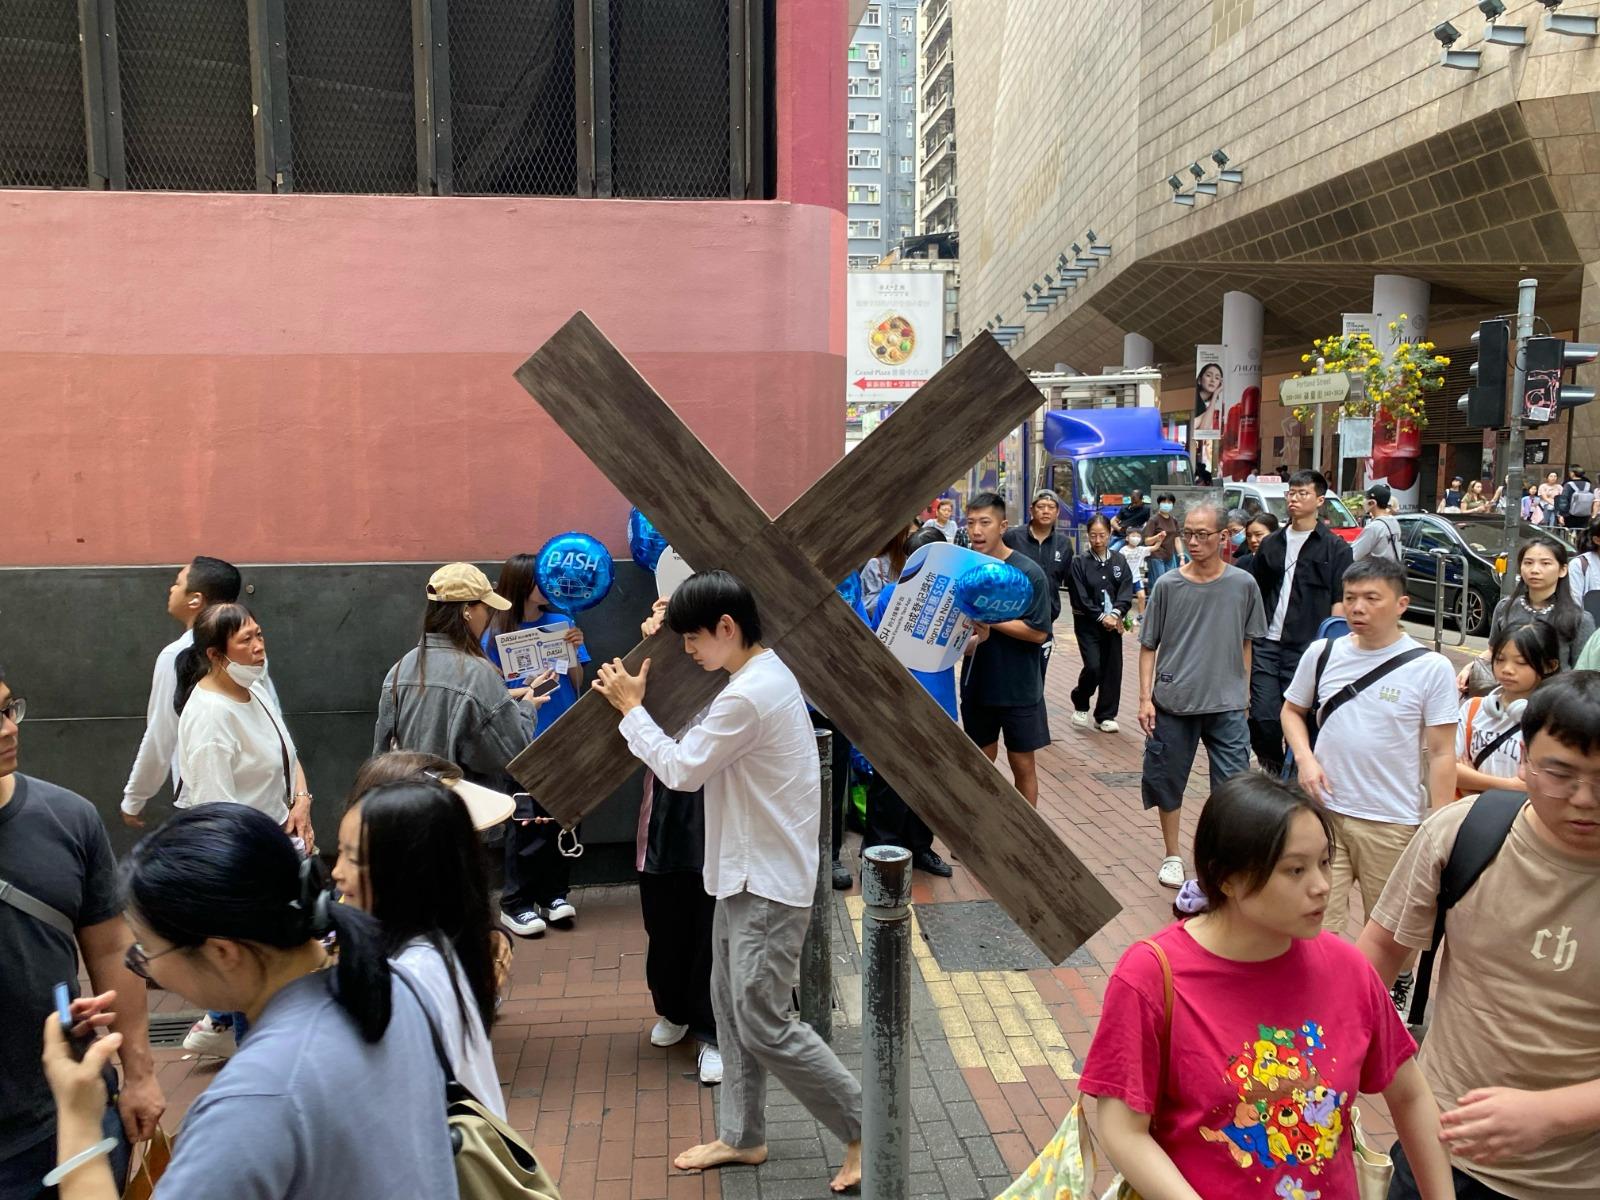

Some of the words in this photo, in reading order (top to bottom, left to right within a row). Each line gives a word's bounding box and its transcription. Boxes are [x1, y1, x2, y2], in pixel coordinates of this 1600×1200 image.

[547, 551, 599, 572] DASH
[940, 596, 953, 616] Now
[973, 595, 1025, 613] DASH
[937, 615, 945, 628] Up
[941, 623, 953, 639] Get
[950, 606, 960, 624] $50
[927, 626, 940, 645] Sign
